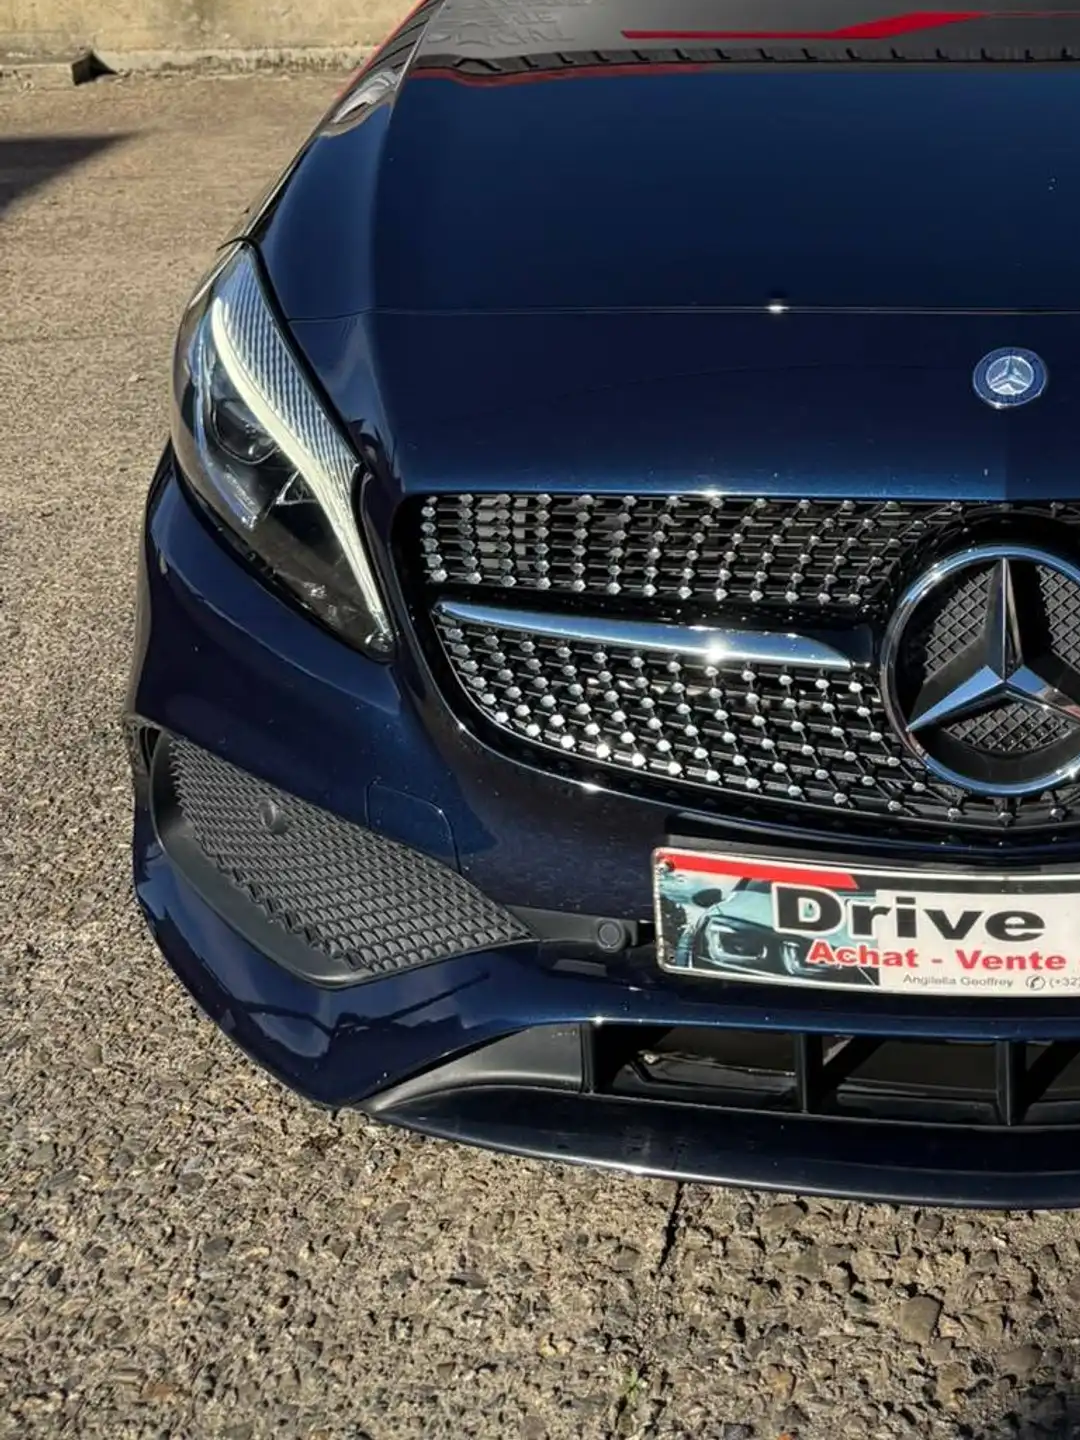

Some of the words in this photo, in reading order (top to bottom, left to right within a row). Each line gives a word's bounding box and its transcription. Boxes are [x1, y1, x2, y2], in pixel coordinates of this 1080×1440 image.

[773, 885, 1046, 943] Drive
[808, 941, 919, 969] Achat
[955, 948, 1067, 971] Vente
